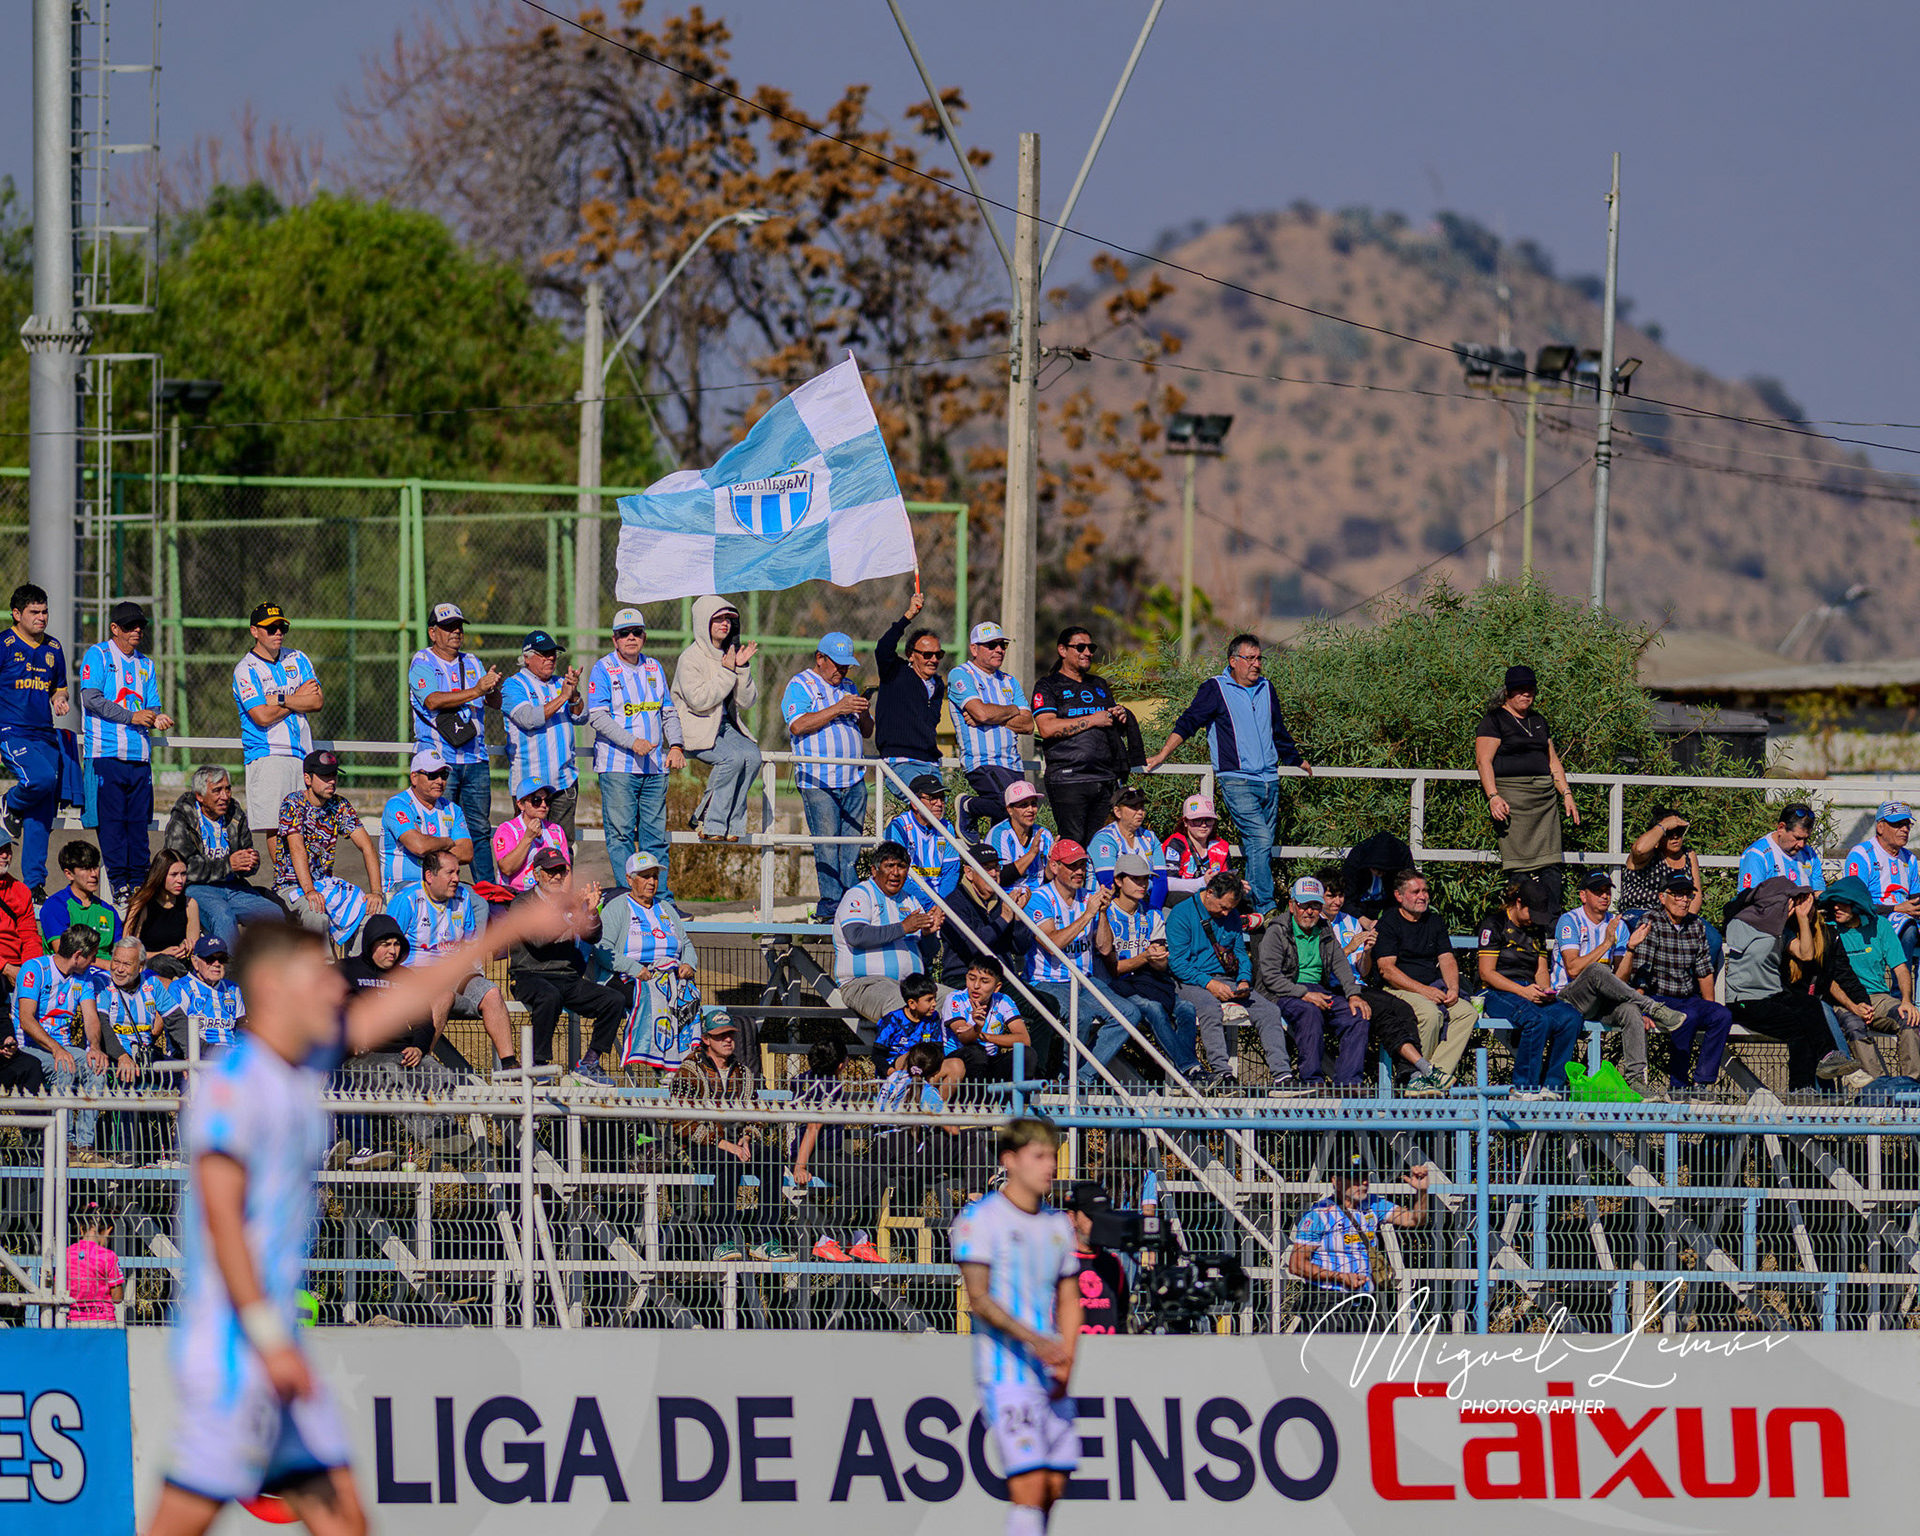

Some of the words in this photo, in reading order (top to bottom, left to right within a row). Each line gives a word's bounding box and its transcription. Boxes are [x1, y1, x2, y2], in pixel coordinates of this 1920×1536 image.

[373, 1395, 630, 1504] LIGA
[657, 1396, 798, 1502] DE
[1366, 1381, 1850, 1501] Caixun
